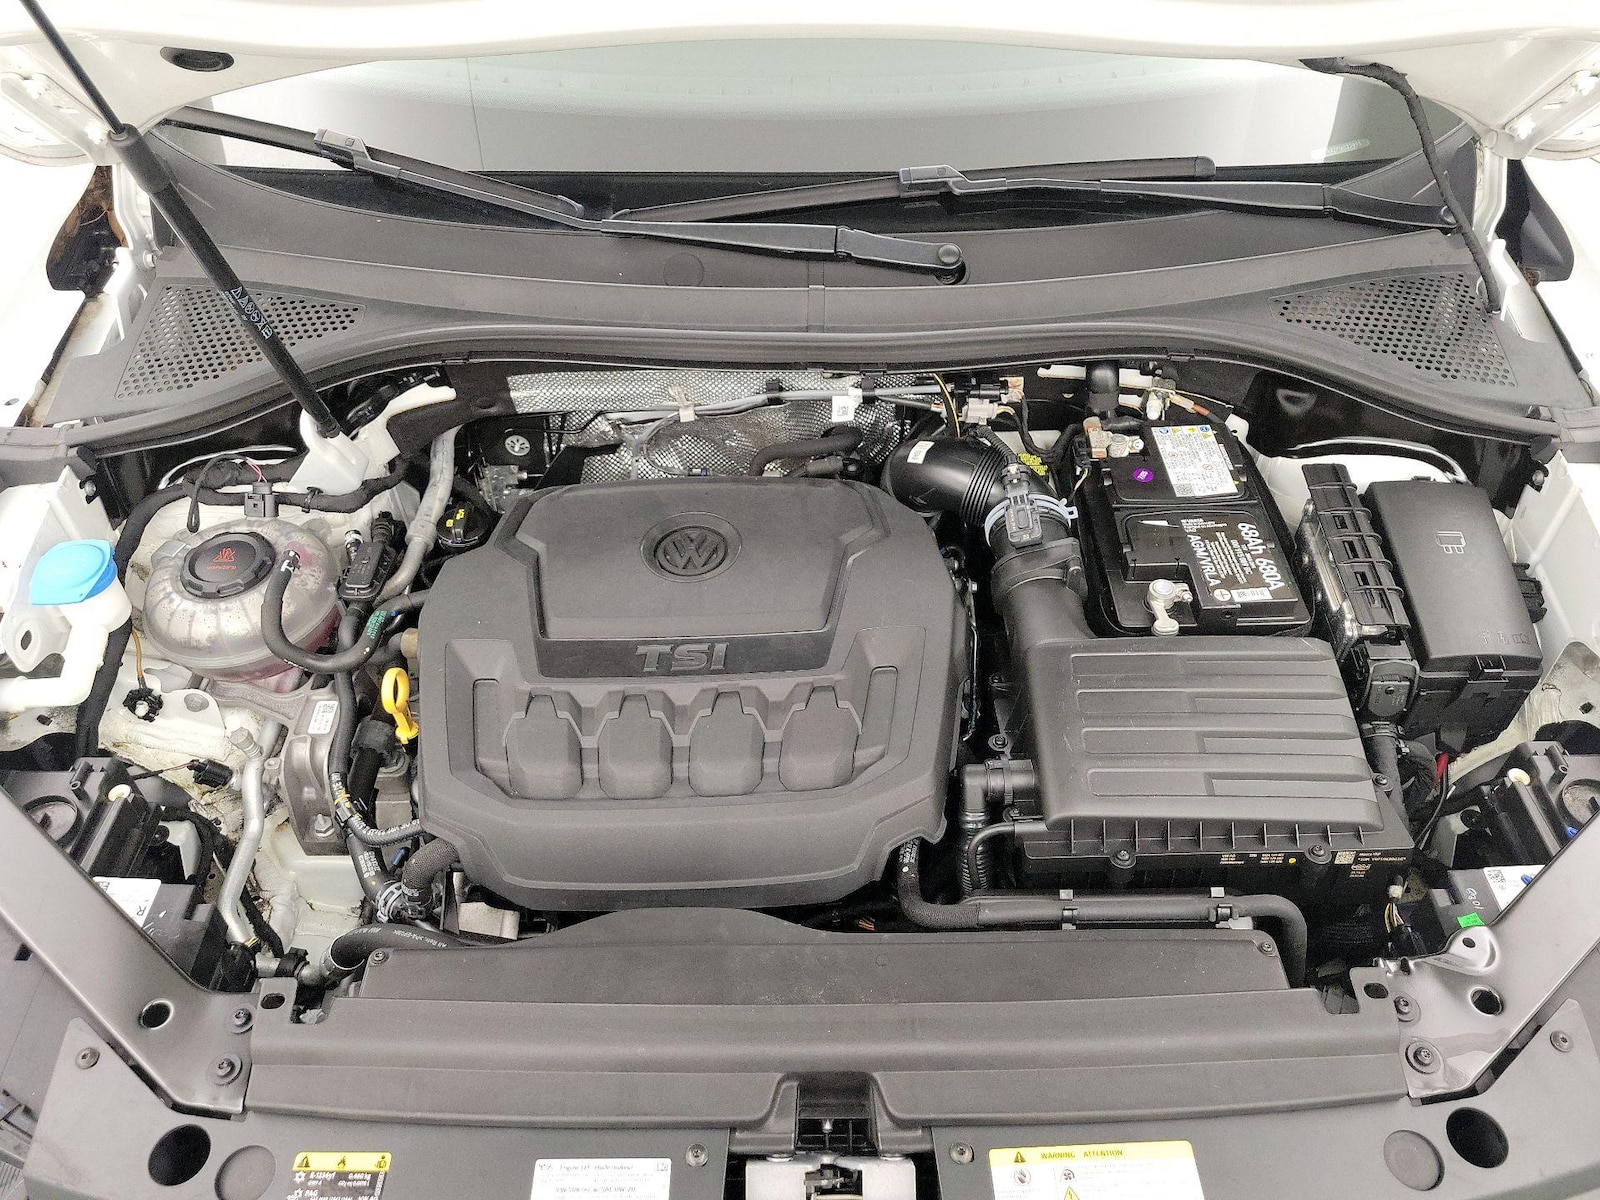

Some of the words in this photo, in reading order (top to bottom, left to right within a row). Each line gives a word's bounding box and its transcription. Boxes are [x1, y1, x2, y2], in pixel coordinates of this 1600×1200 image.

[1187, 534, 1221, 586] AGM/VRLA
[1238, 522, 1266, 554] 68Ah
[1256, 557, 1285, 590] 680A
[636, 642, 729, 673] TSI
[1041, 1151, 1075, 1159] WARNING
[1083, 1149, 1123, 1158] ATTENTION
